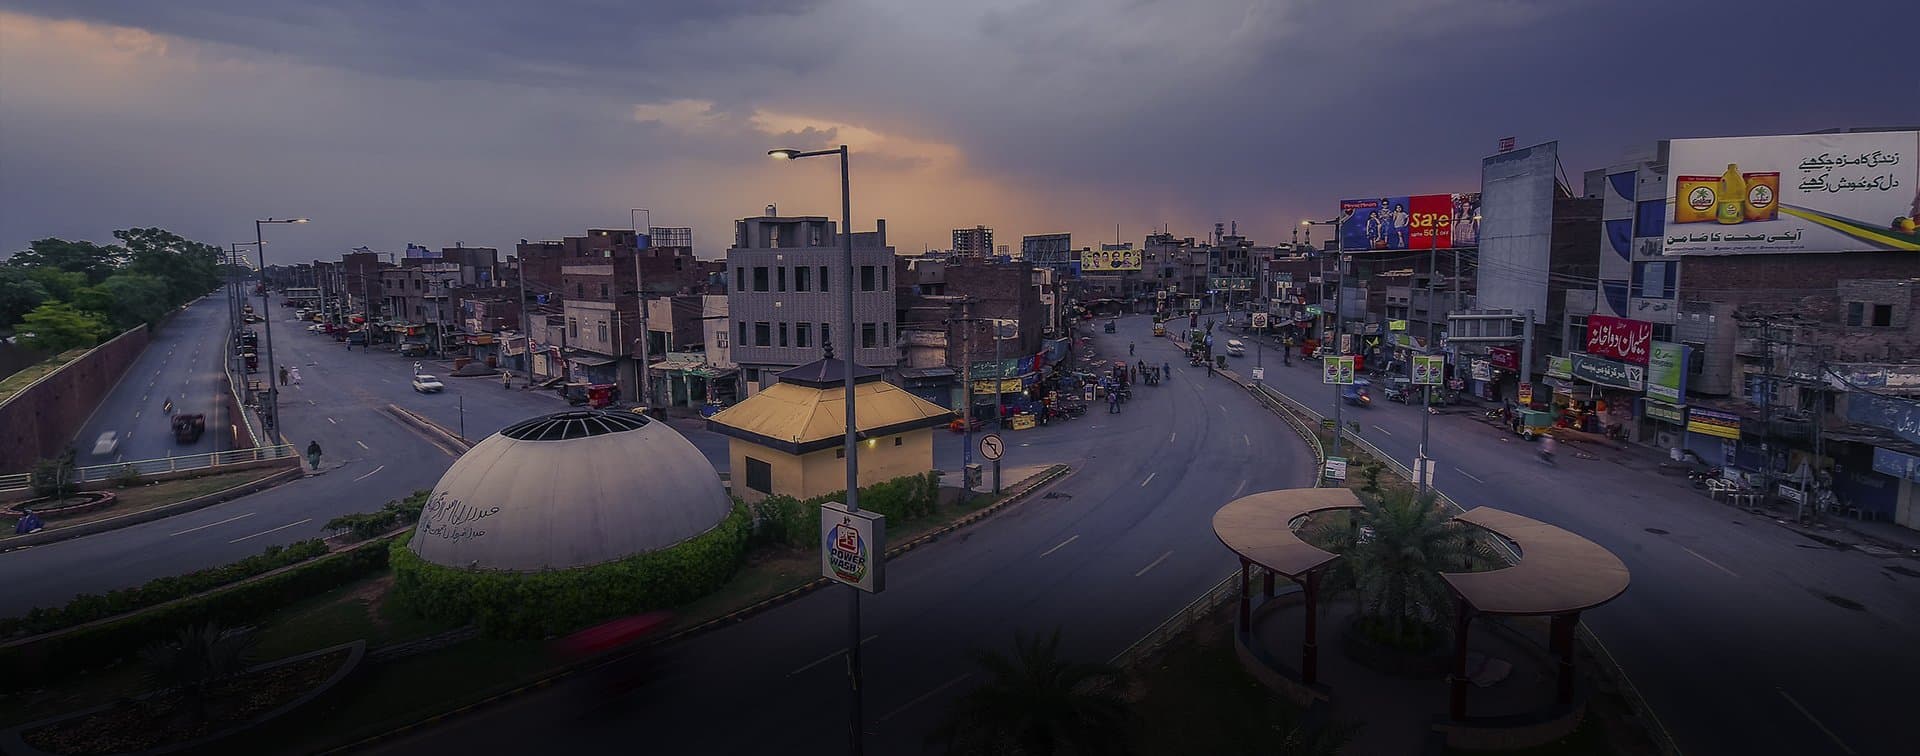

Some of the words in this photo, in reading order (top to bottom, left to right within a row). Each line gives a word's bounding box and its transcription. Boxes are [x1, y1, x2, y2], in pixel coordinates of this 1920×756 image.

[1836, 154, 1860, 168] مزہ
[1860, 153, 1871, 164] کا
[1867, 150, 1899, 167] زندگی
[1865, 176, 1884, 191] کو
[1879, 173, 1899, 191] دل
[1710, 232, 1721, 241] کا
[1724, 233, 1765, 241] صحت
[1618, 324, 1649, 357] سلیمان
[831, 548, 865, 565] POWER
[830, 557, 857, 573] WASH
